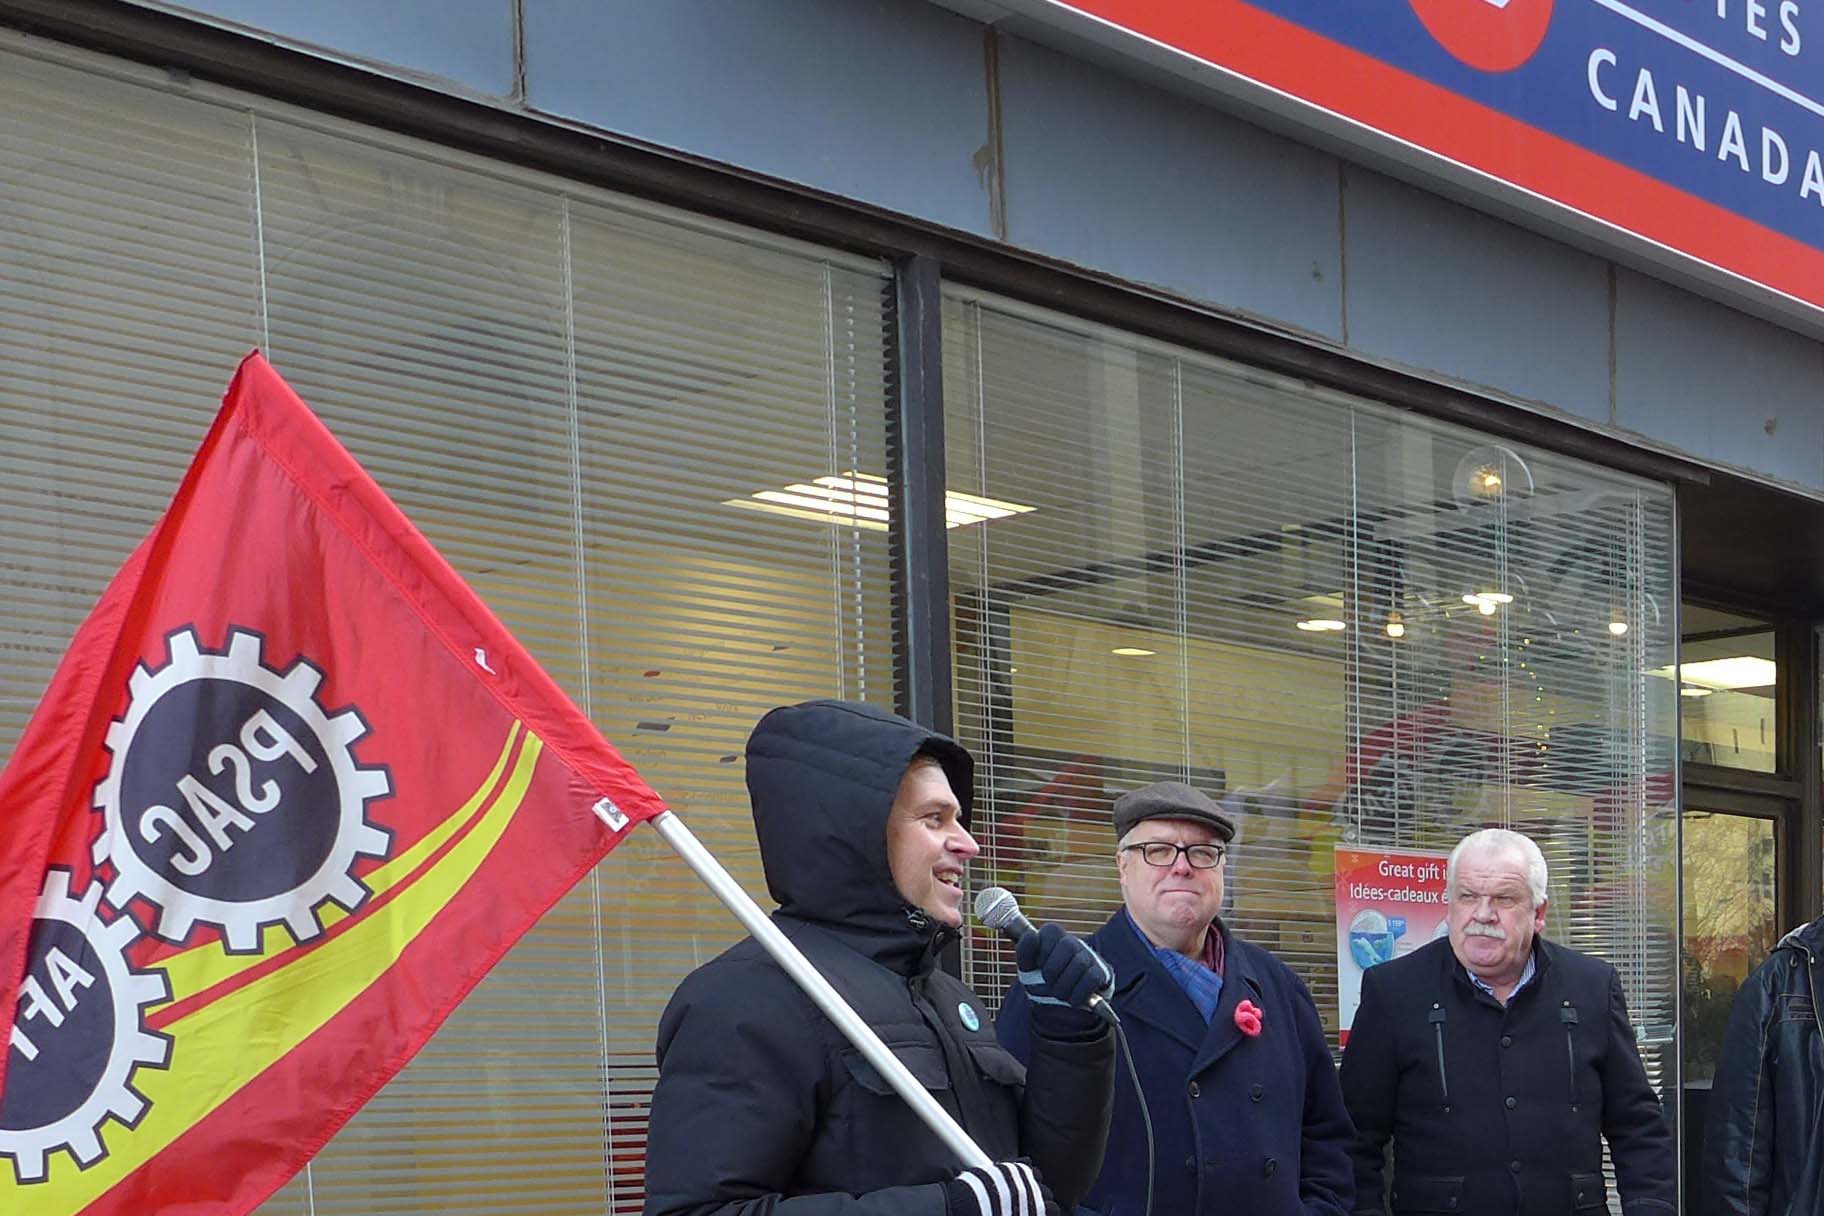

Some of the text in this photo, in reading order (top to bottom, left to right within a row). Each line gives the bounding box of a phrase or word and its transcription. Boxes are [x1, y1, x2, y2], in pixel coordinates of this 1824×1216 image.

[1378, 860, 1414, 879] Great
[1417, 862, 1439, 883] gift
[1350, 882, 1439, 904] Idées-cadeaux
